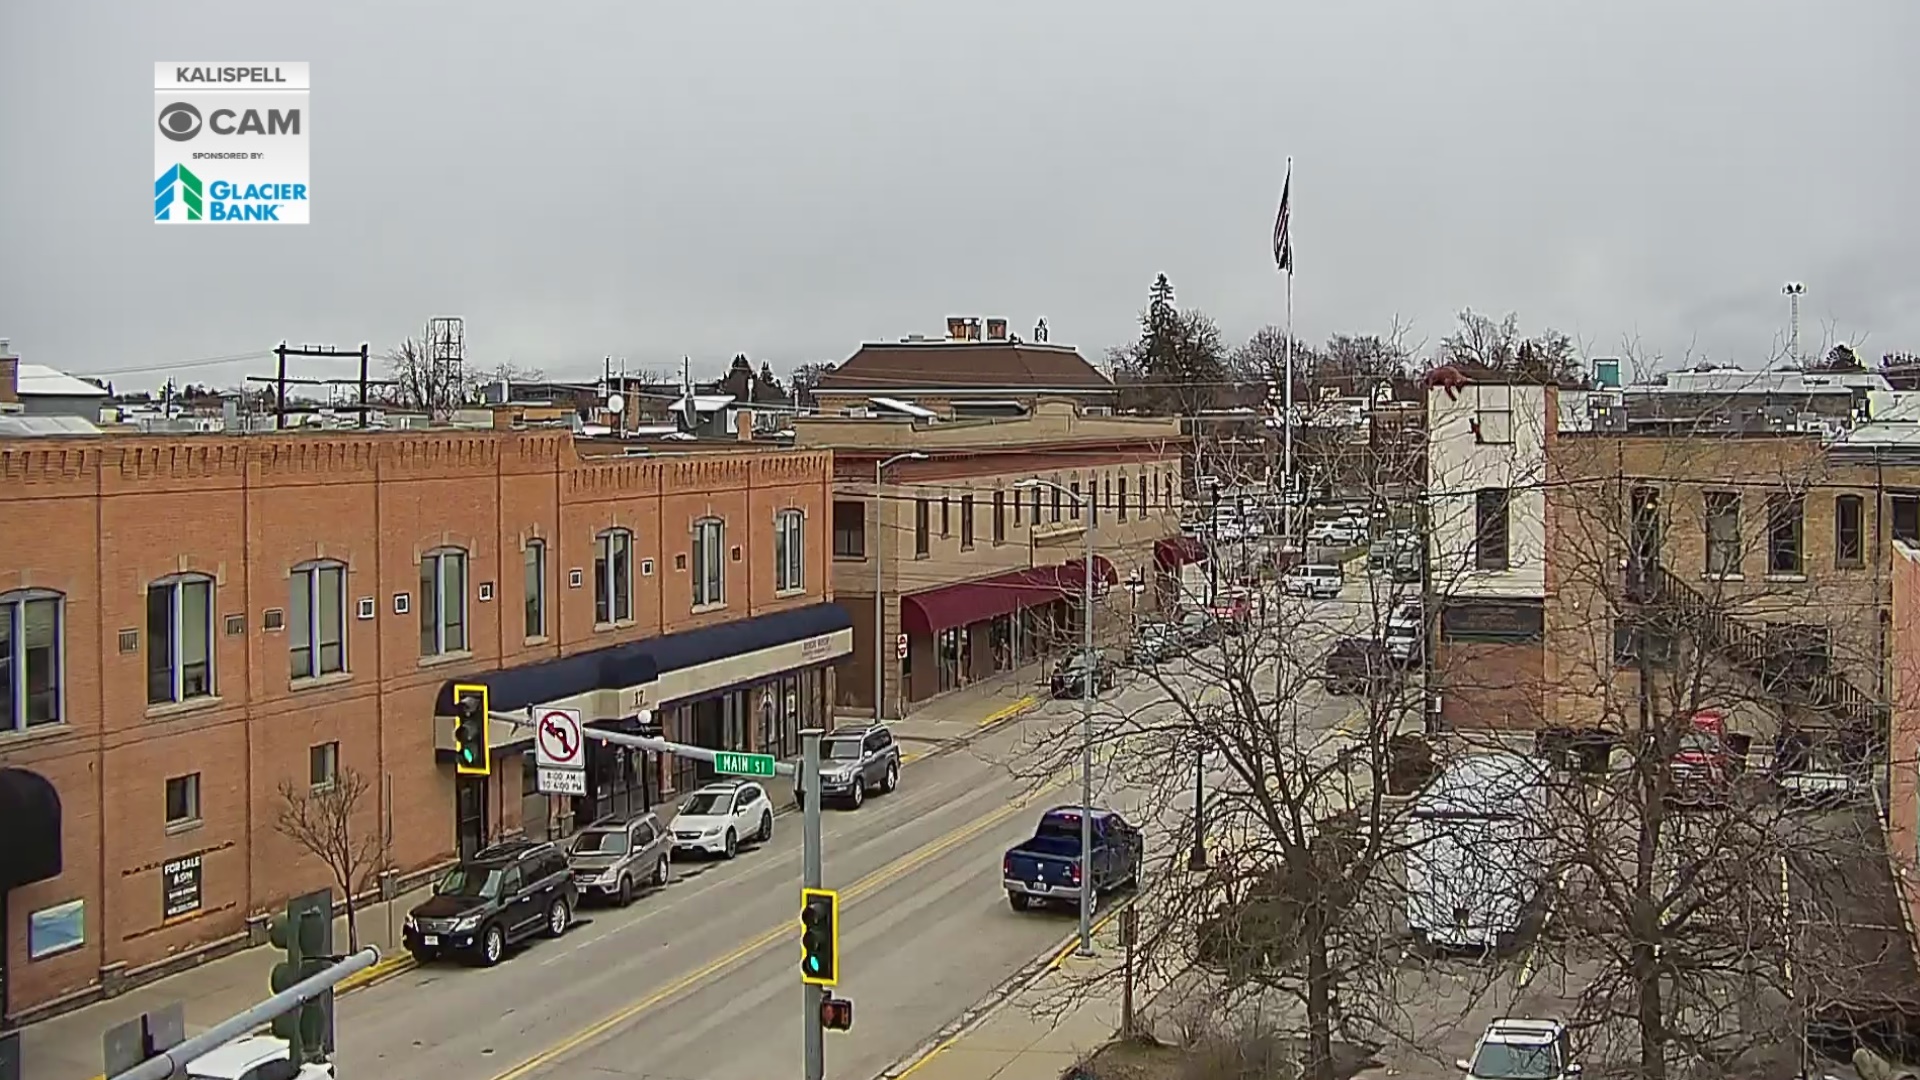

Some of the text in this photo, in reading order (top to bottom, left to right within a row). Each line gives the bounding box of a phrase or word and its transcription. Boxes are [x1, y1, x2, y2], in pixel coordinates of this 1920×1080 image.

[634, 690, 645, 706] 17
[723, 755, 766, 773] MAIN ST
[164, 856, 200, 875] FOR SALE
